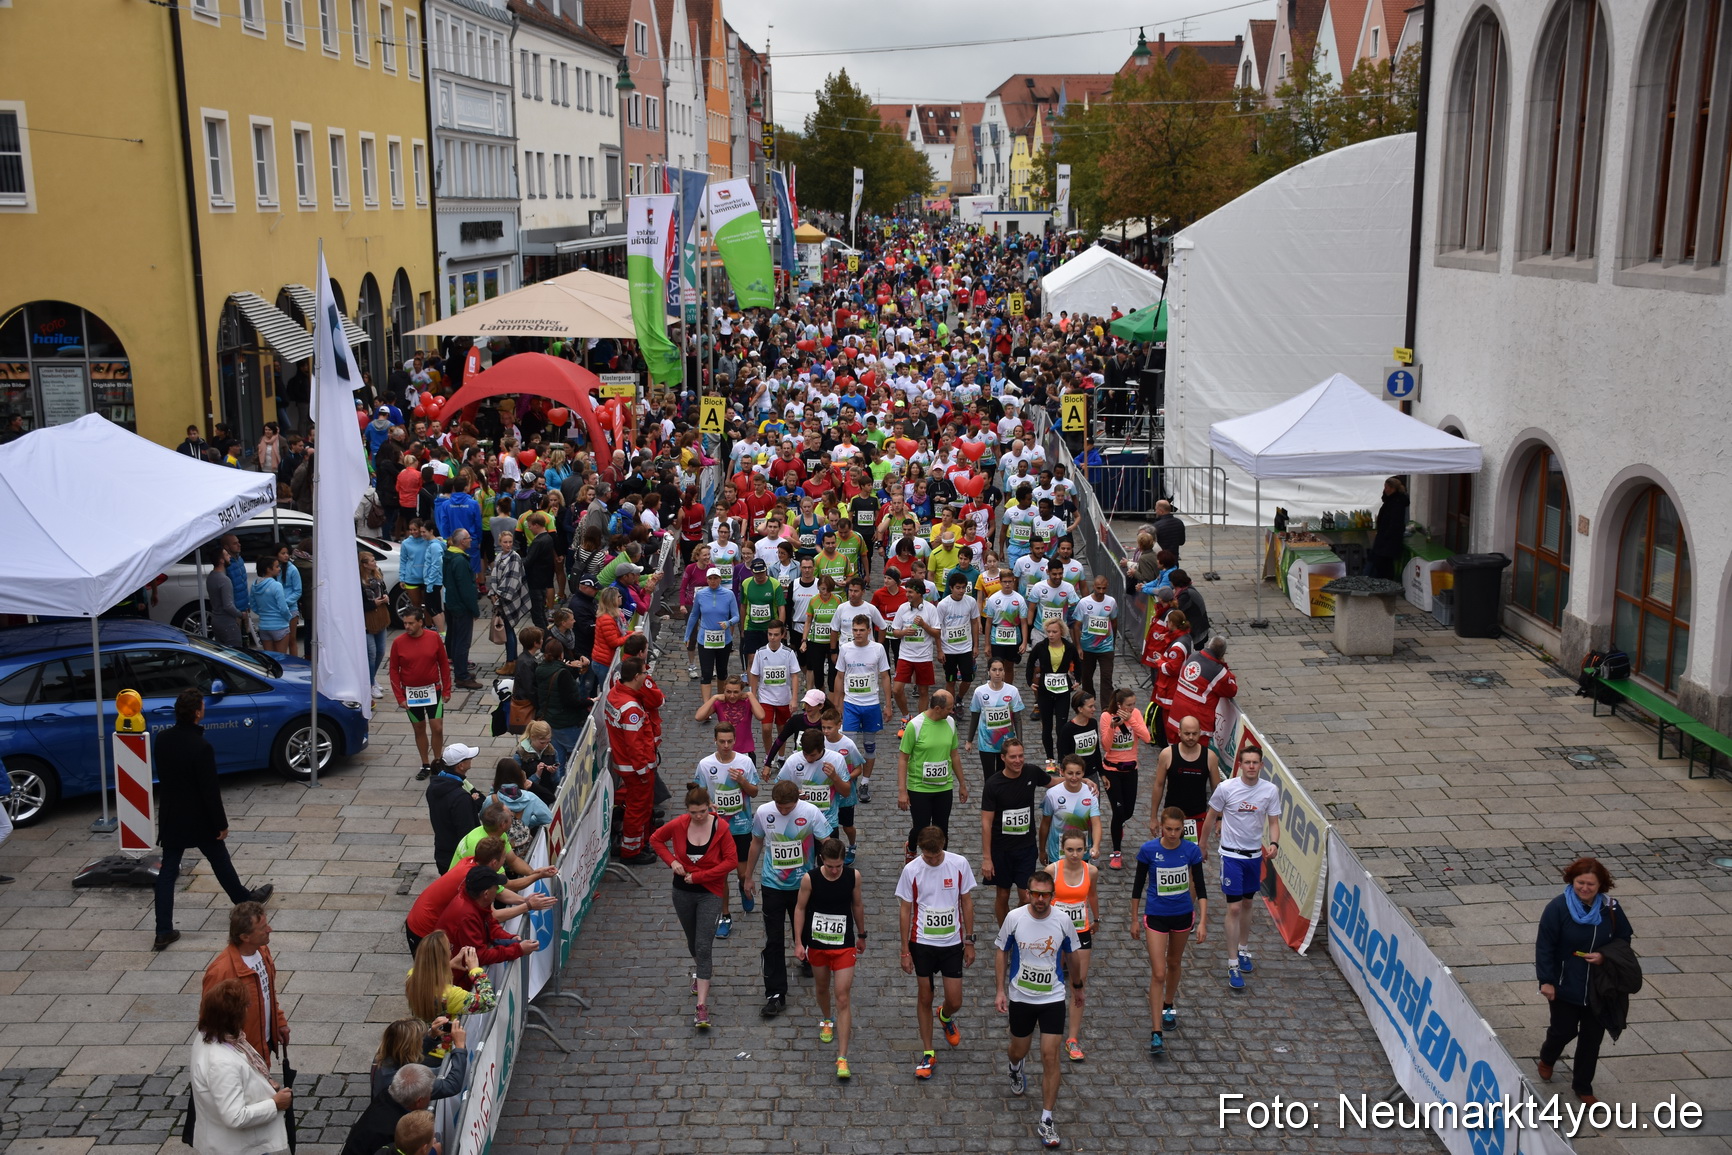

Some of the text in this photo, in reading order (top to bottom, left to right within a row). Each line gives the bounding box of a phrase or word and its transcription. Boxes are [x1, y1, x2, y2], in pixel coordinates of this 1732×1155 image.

[710, 201, 751, 216] Lammsbräu
[850, 260, 856, 268] C
[1013, 300, 1022, 311] B
[479, 323, 569, 332] Lammsbräu
[496, 318, 561, 326] Neumarkter
[704, 398, 723, 406] Block
[1064, 395, 1084, 403] Block
[705, 408, 719, 426] A
[1067, 405, 1082, 423] A
[218, 505, 240, 528] PARTL
[1310, 597, 1336, 613] Lamms
[752, 608, 769, 617] 5023
[706, 634, 723, 642] 5341
[948, 628, 966, 639] 5192
[765, 670, 785, 679] 5038
[850, 678, 869, 687] 5197
[408, 690, 429, 699] 2605
[989, 710, 1009, 721] 5026
[1078, 736, 1096, 749] 5091
[926, 766, 947, 777] 5320
[718, 795, 741, 806] 5089
[1006, 814, 1029, 826] 5158
[775, 847, 800, 859] 5070
[1161, 872, 1187, 885] 5000
[926, 913, 954, 927] 5309
[815, 920, 844, 934] 5146
[1021, 969, 1052, 984] 5300
[1329, 880, 1467, 1083] slachstar
